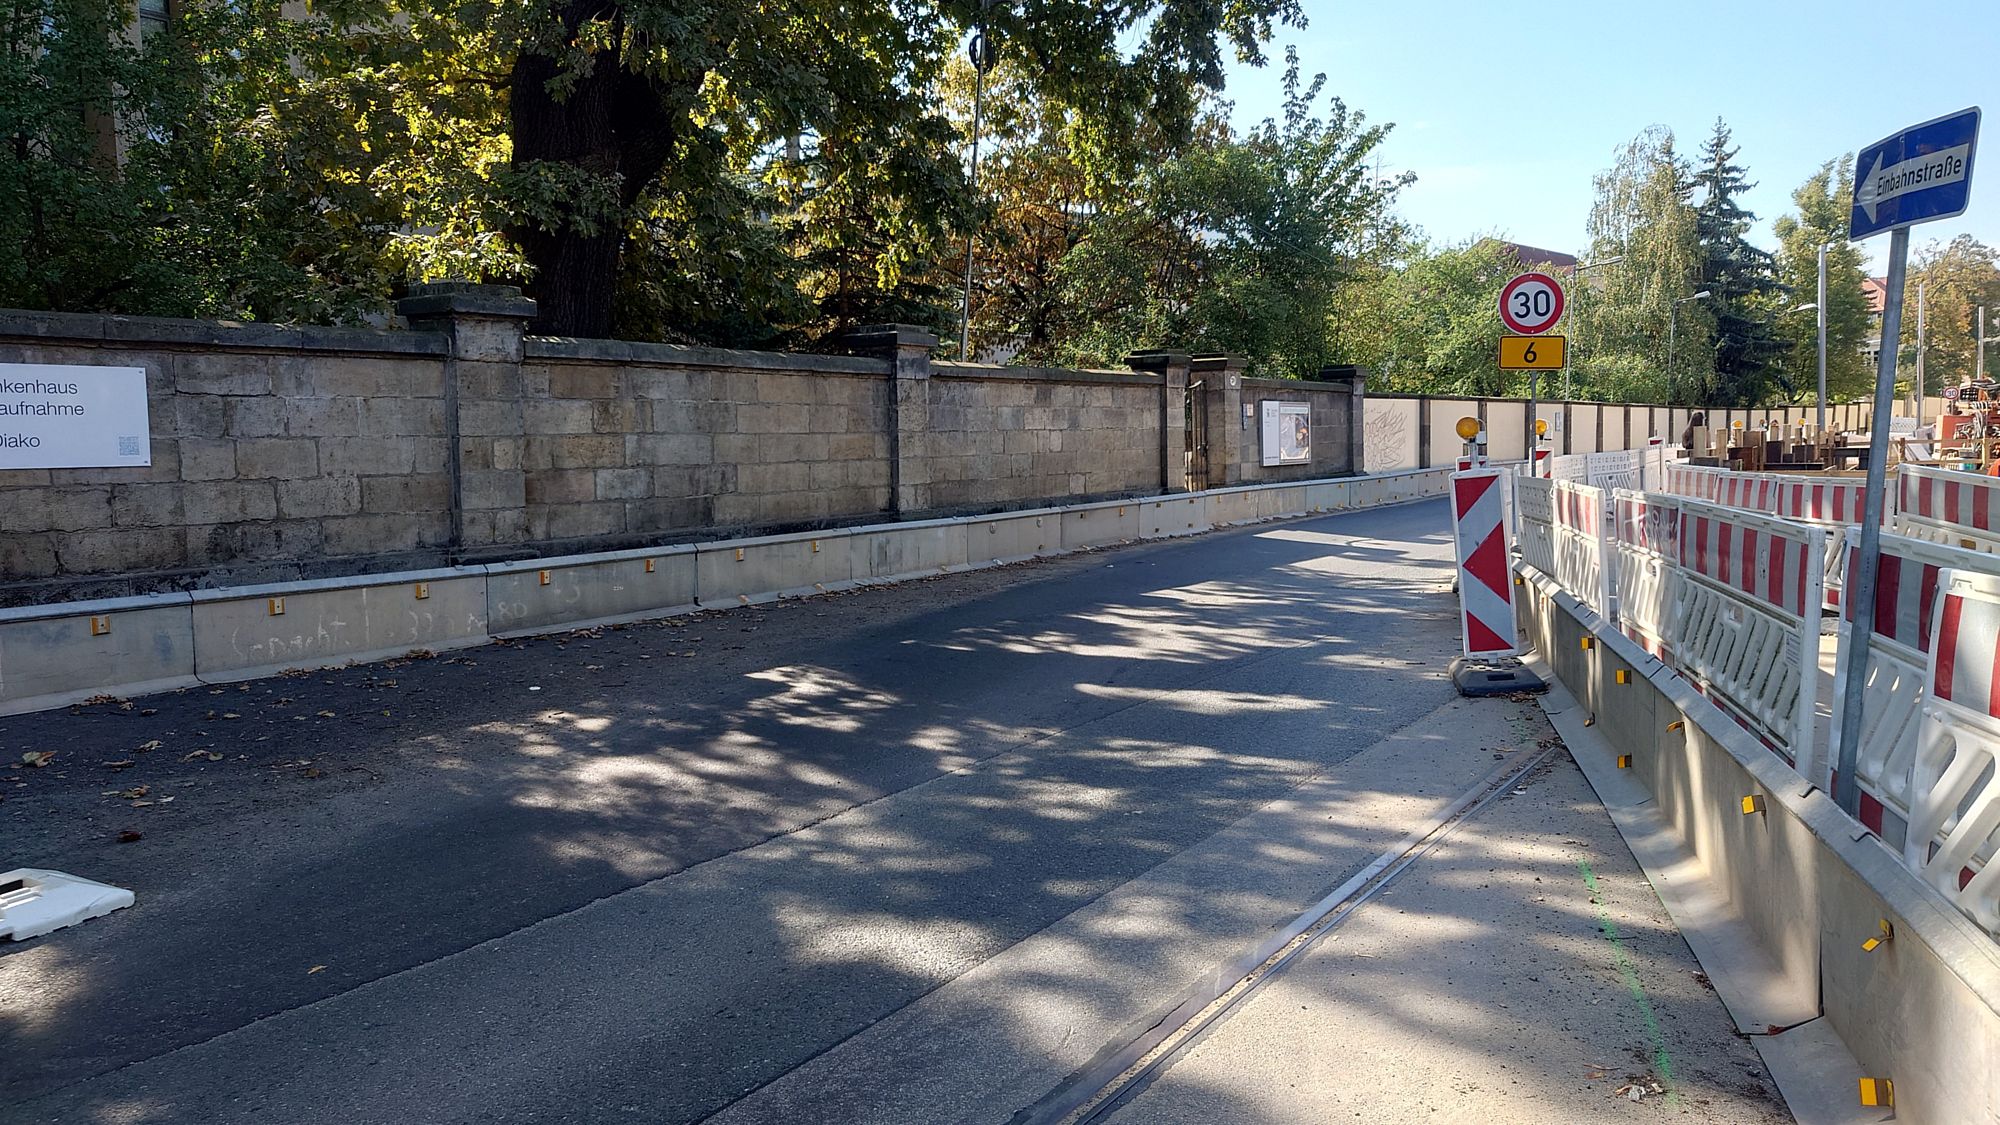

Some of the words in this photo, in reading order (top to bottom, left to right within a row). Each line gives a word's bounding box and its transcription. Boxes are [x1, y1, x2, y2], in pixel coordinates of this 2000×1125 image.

[1876, 155, 1962, 197] Einbahnstraße
[1513, 290, 1551, 319] 30
[1523, 341, 1537, 364] 6
[0, 378, 78, 394] kenhaus
[0, 433, 41, 448] iako
